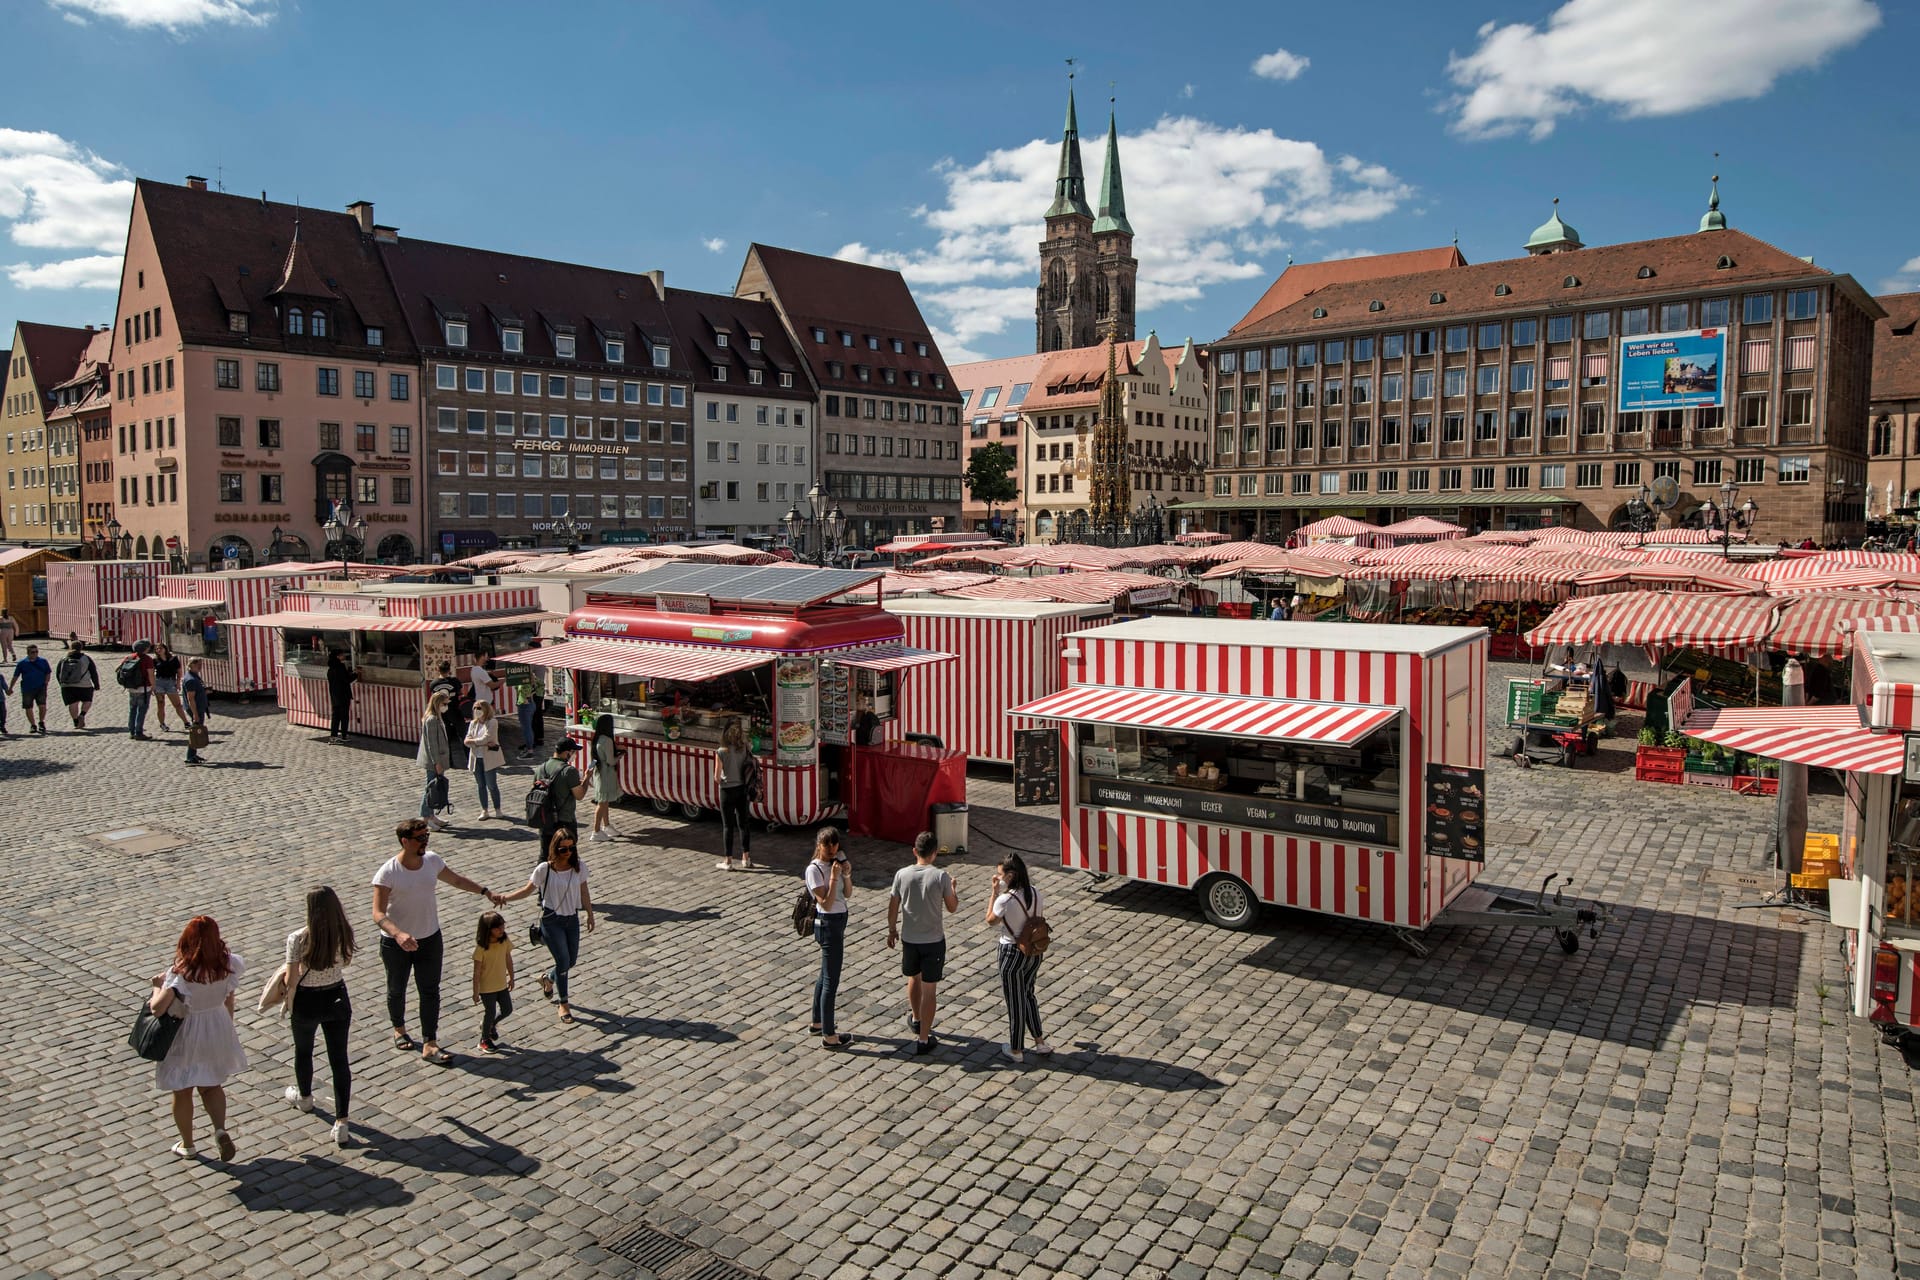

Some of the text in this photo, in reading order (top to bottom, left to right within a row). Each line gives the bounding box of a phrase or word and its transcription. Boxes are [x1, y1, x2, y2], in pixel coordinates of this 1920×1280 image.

[568, 443, 629, 454] IMMOBILIEN
[261, 513, 291, 522] BERG
[366, 512, 408, 522] BÜCHER
[652, 525, 684, 533] LINCURA
[329, 599, 361, 611] FALAFEL
[661, 599, 686, 609] FALAFEL
[595, 617, 629, 633] Palmyra
[1098, 788, 1376, 834] OFENFRISCH HAUSGEMACHT LECKER VEGAN QUALITÄT UND TRADITION
